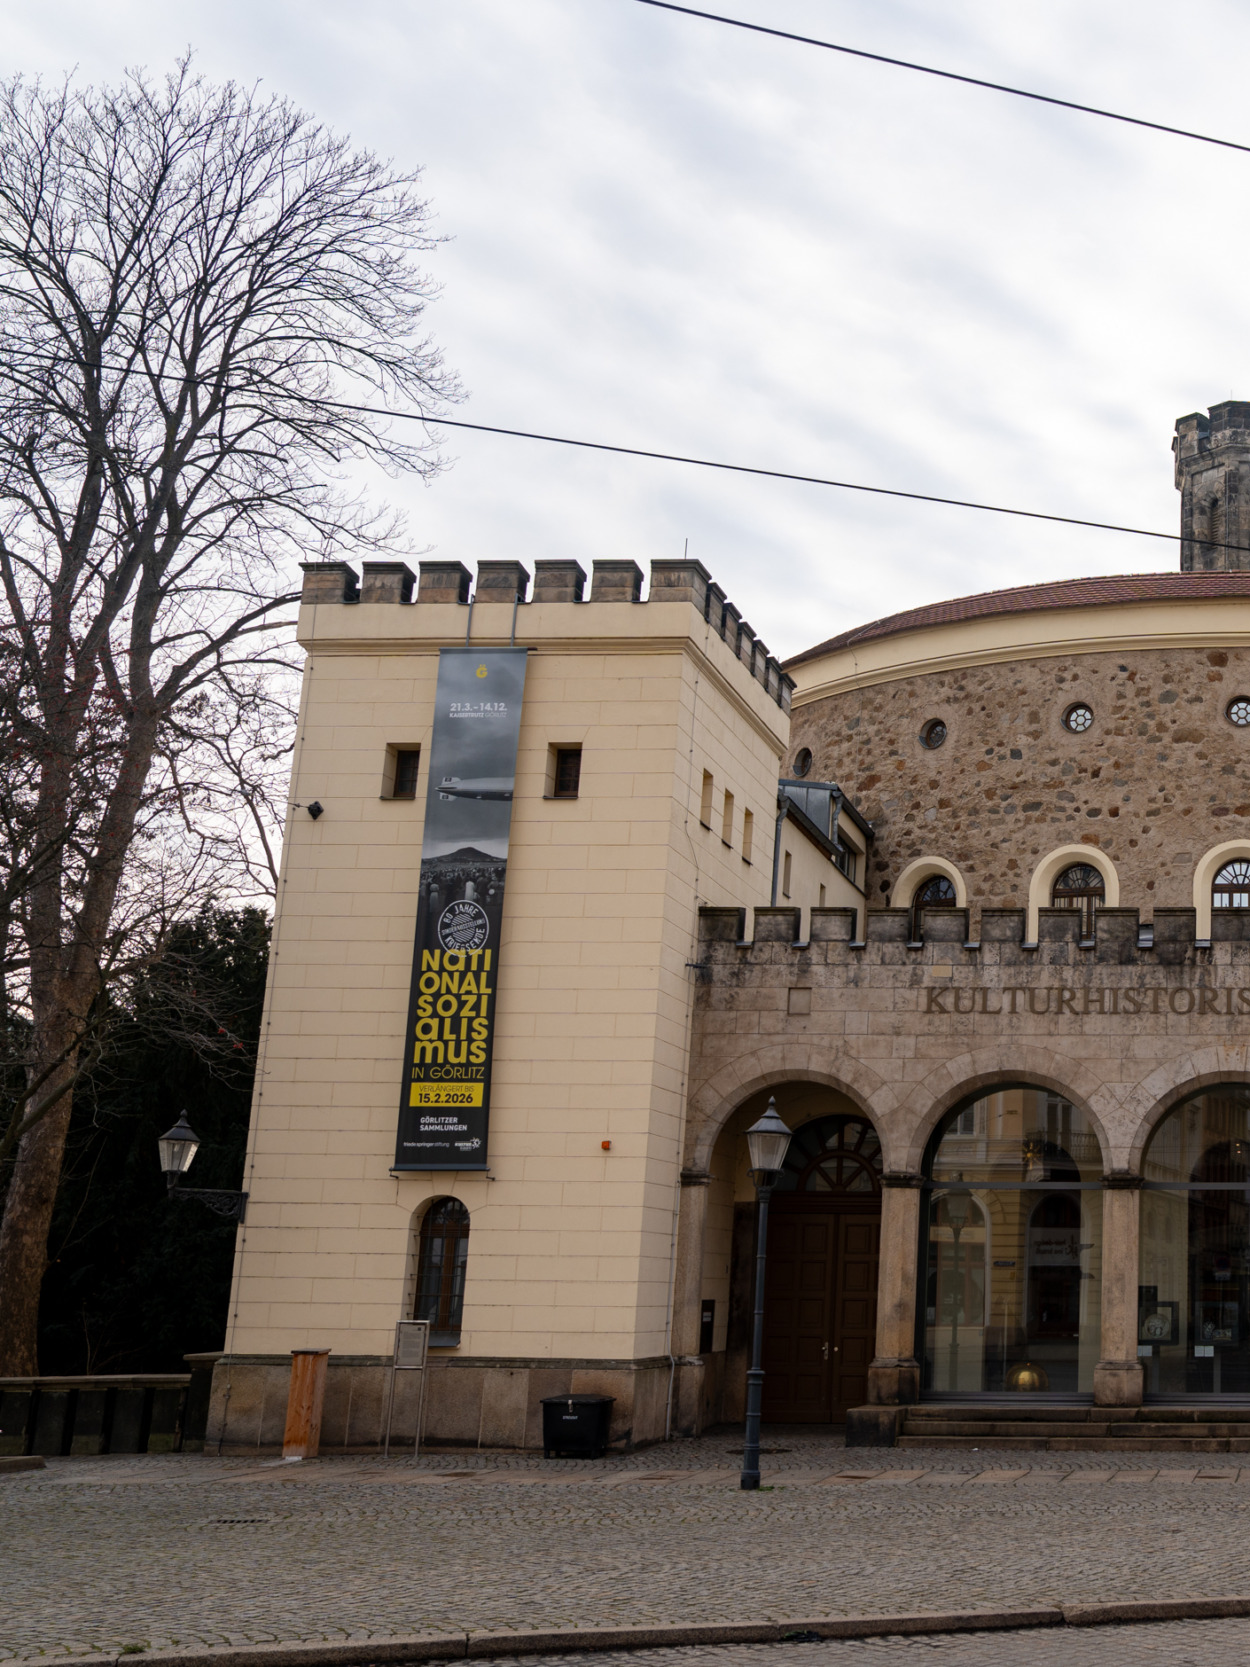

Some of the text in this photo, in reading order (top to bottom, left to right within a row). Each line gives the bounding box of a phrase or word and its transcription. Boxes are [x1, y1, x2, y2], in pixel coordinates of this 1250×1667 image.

[443, 903, 479, 924] 80 JAHRE
[444, 927, 486, 952] KRIEGSENDE
[419, 971, 492, 994] ONAL
[416, 994, 489, 1017] SOZI
[413, 1040, 487, 1064] mus
[411, 1064, 485, 1079] IN GÖRLITZ
[418, 1093, 473, 1104] 15.2.2026
[419, 1084, 463, 1092] VERLÄNGERT
[420, 1115, 458, 1124] GÖRLITZER
